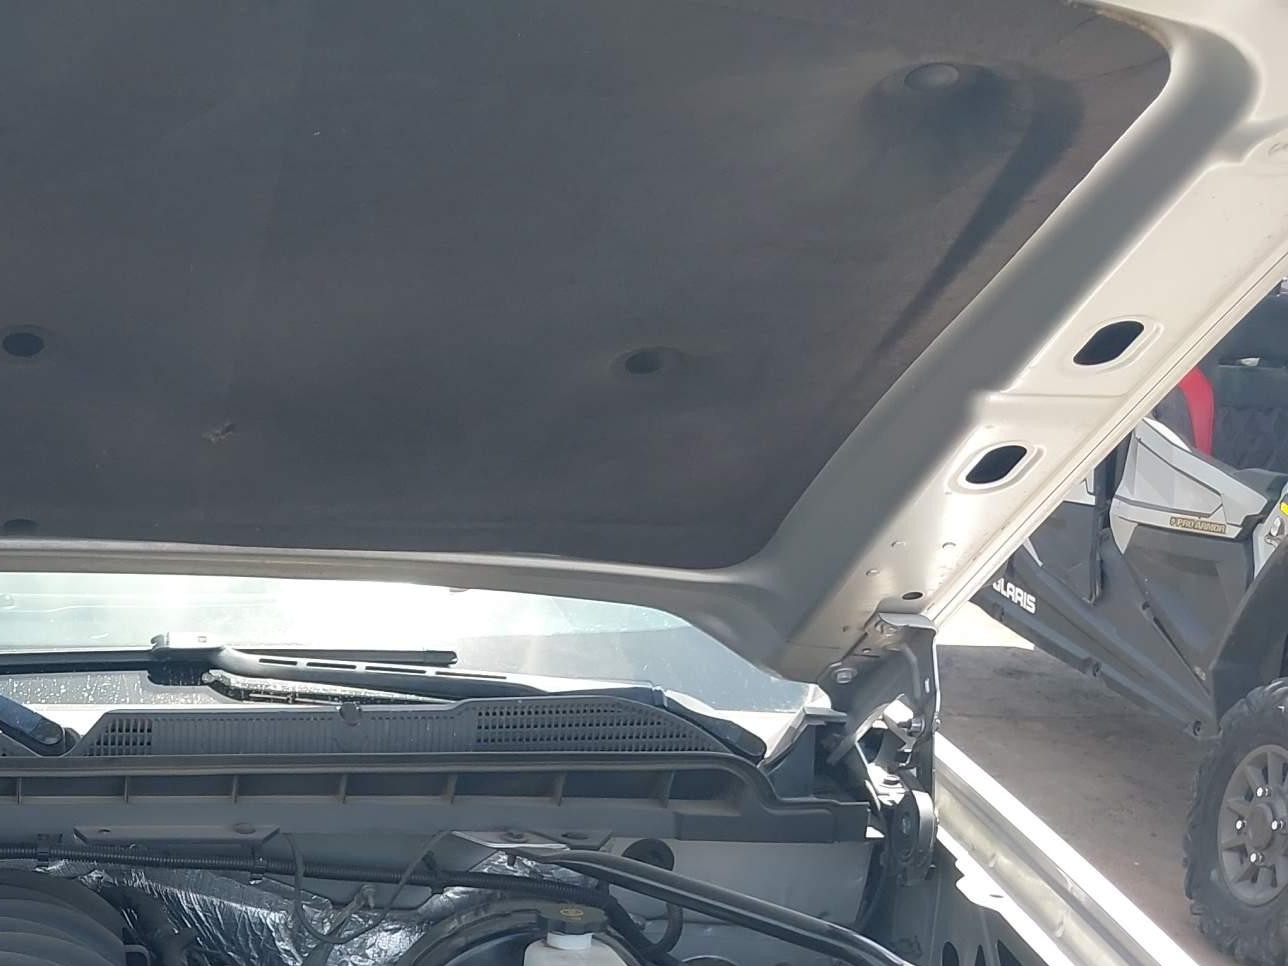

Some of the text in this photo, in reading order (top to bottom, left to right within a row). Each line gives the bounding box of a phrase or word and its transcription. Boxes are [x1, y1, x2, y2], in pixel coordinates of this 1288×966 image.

[1176, 518, 1226, 533] PRO ARMOR
[993, 577, 1036, 614] OLARIS
